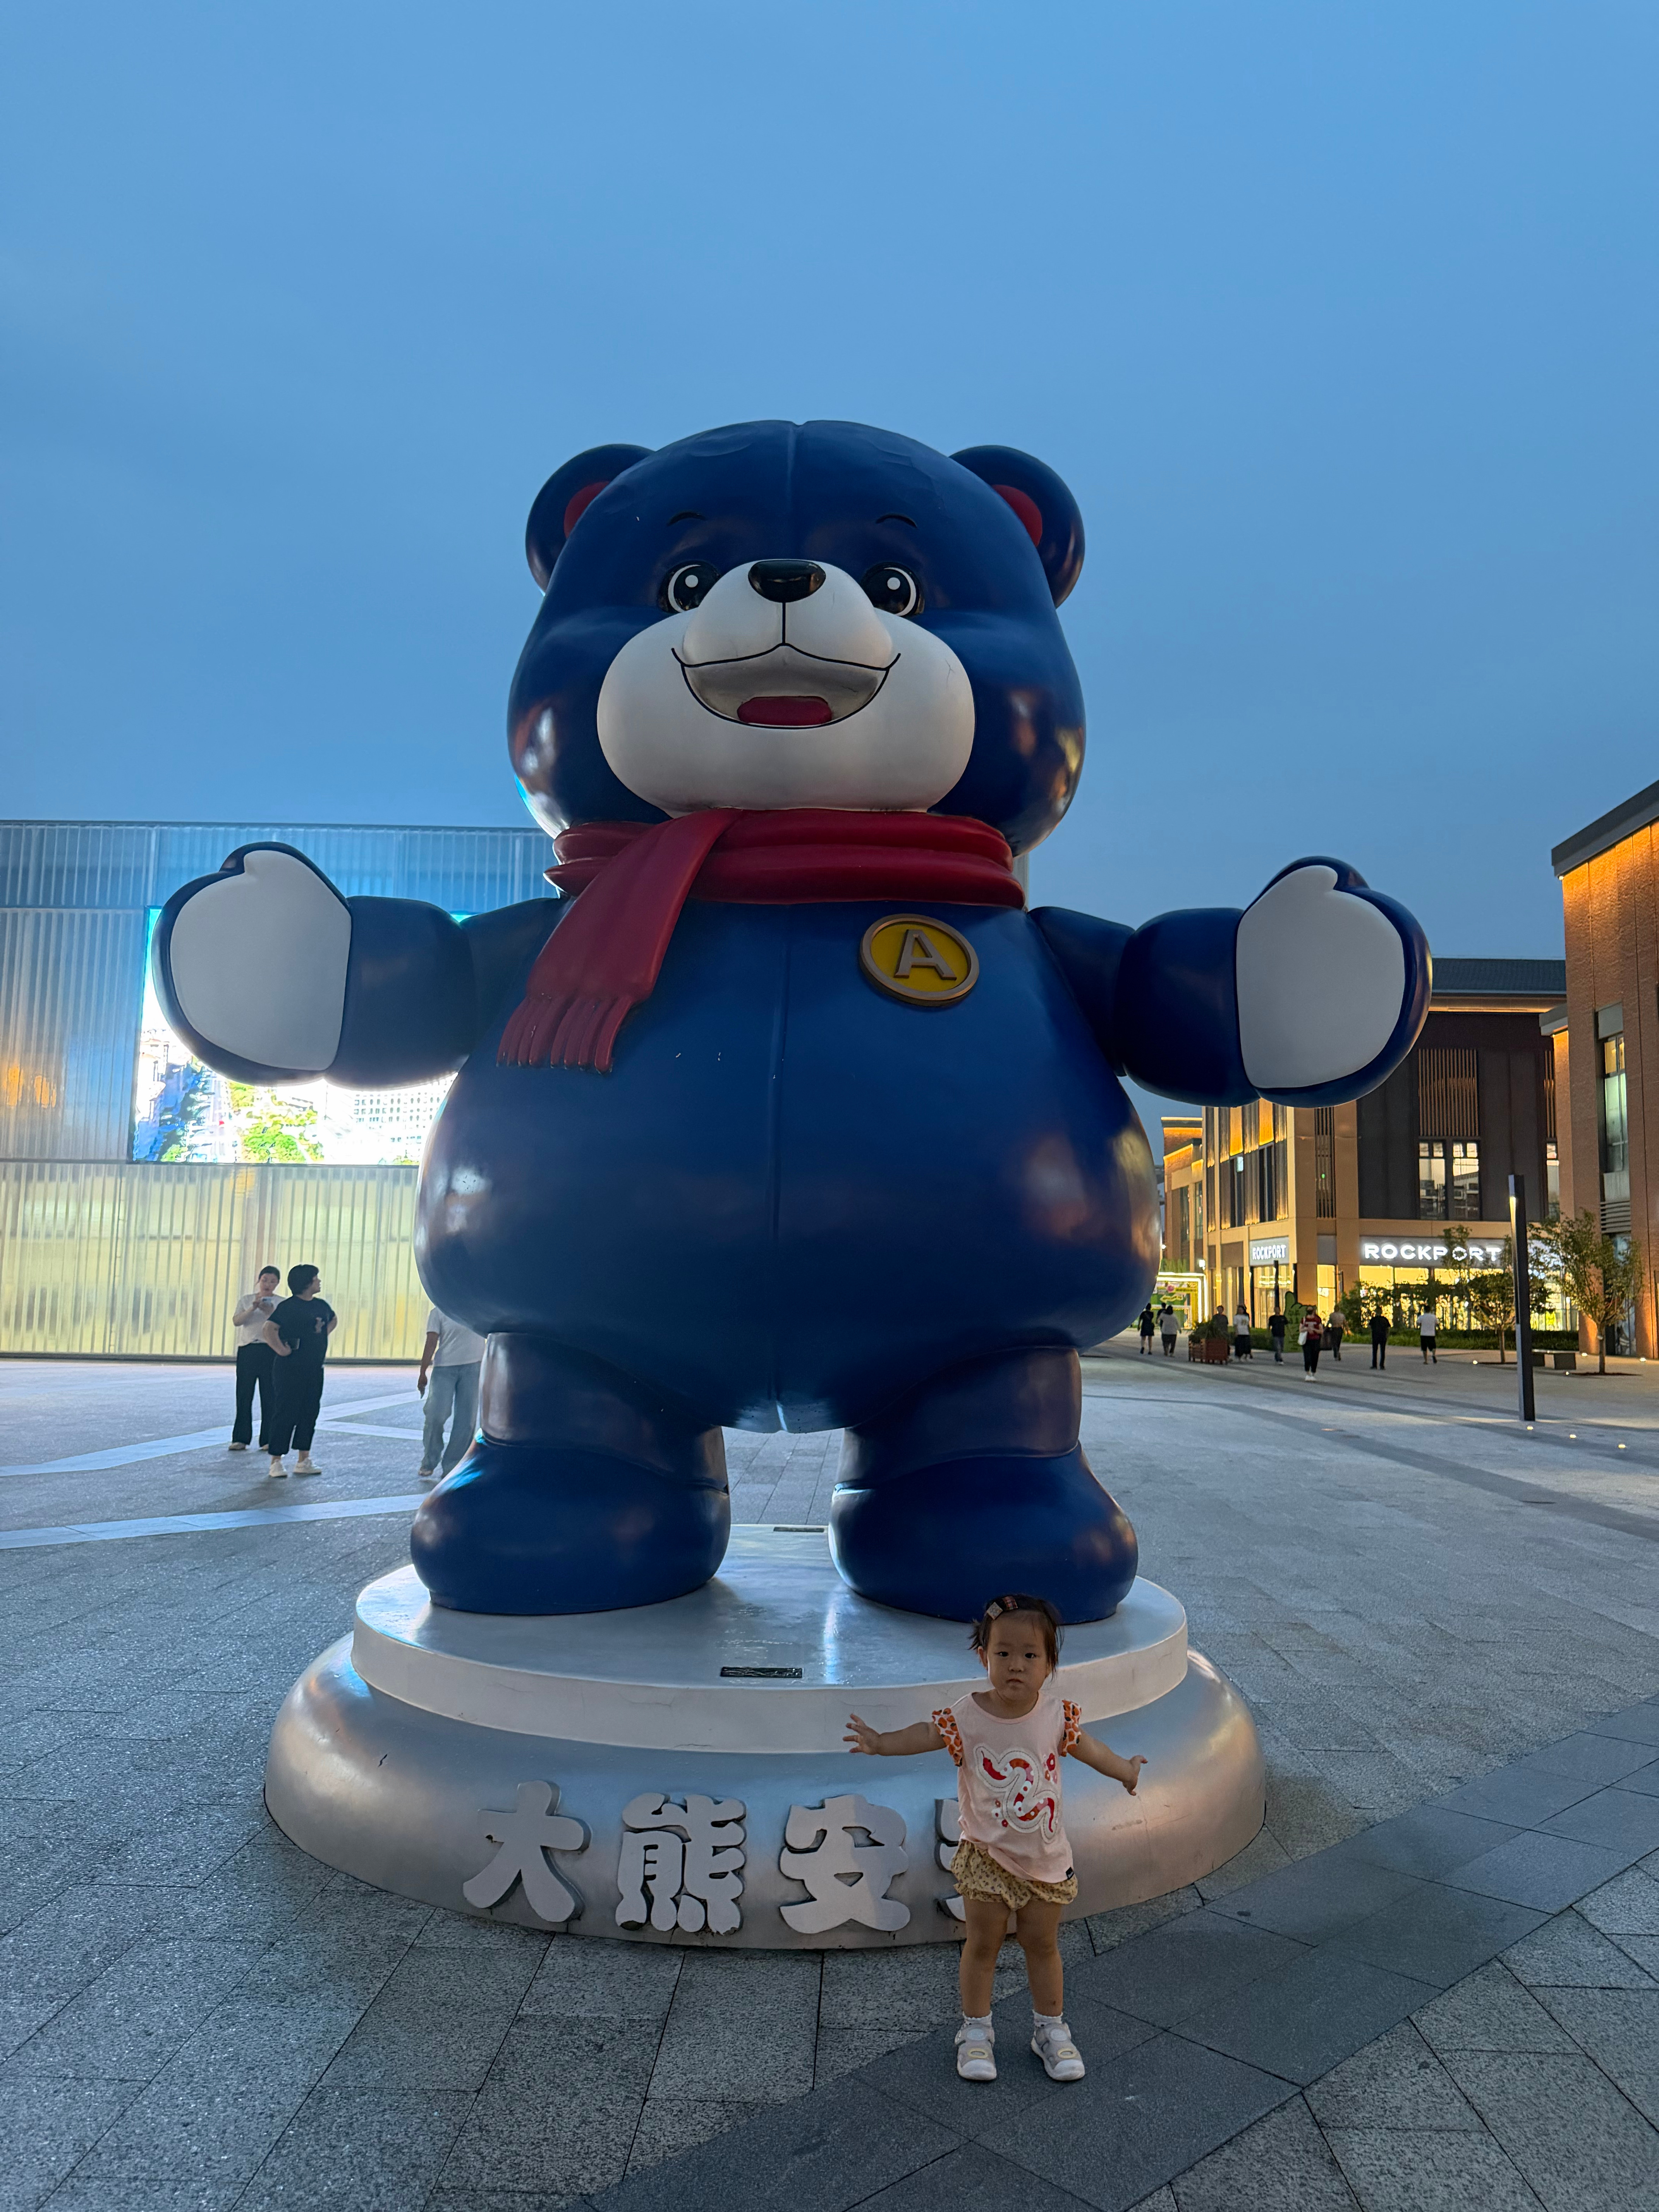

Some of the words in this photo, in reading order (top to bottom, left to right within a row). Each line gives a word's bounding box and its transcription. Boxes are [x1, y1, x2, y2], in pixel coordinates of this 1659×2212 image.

[894, 929, 957, 981] A
[1252, 1244, 1286, 1260] ROCKPORT
[1364, 1244, 1502, 1261] ROCKPORT
[463, 1780, 966, 1935] 大熊安
